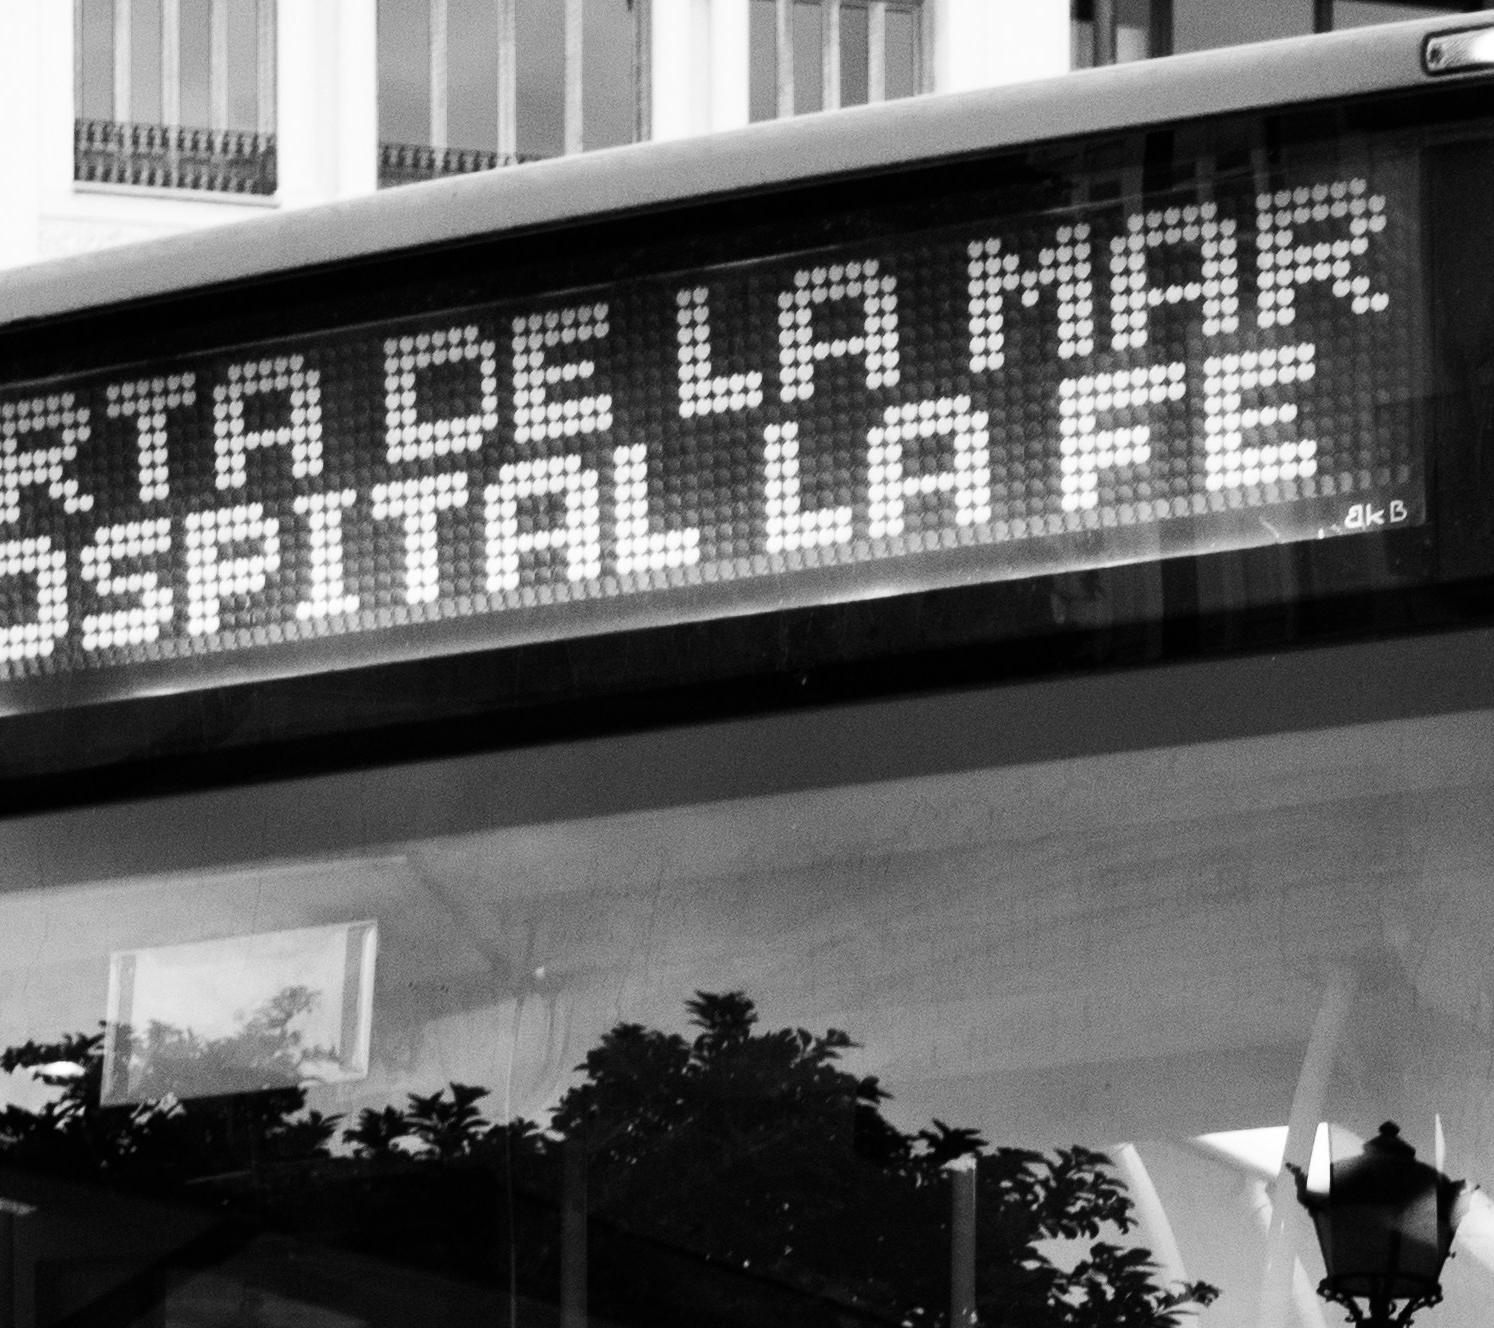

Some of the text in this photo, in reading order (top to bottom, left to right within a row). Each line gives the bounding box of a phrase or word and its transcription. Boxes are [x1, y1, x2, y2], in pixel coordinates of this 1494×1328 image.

[383, 302, 613, 464] DE
[676, 258, 900, 419] LA
[967, 177, 1390, 374] MAR
[763, 394, 991, 554] LA
[1059, 342, 1317, 512] FE
